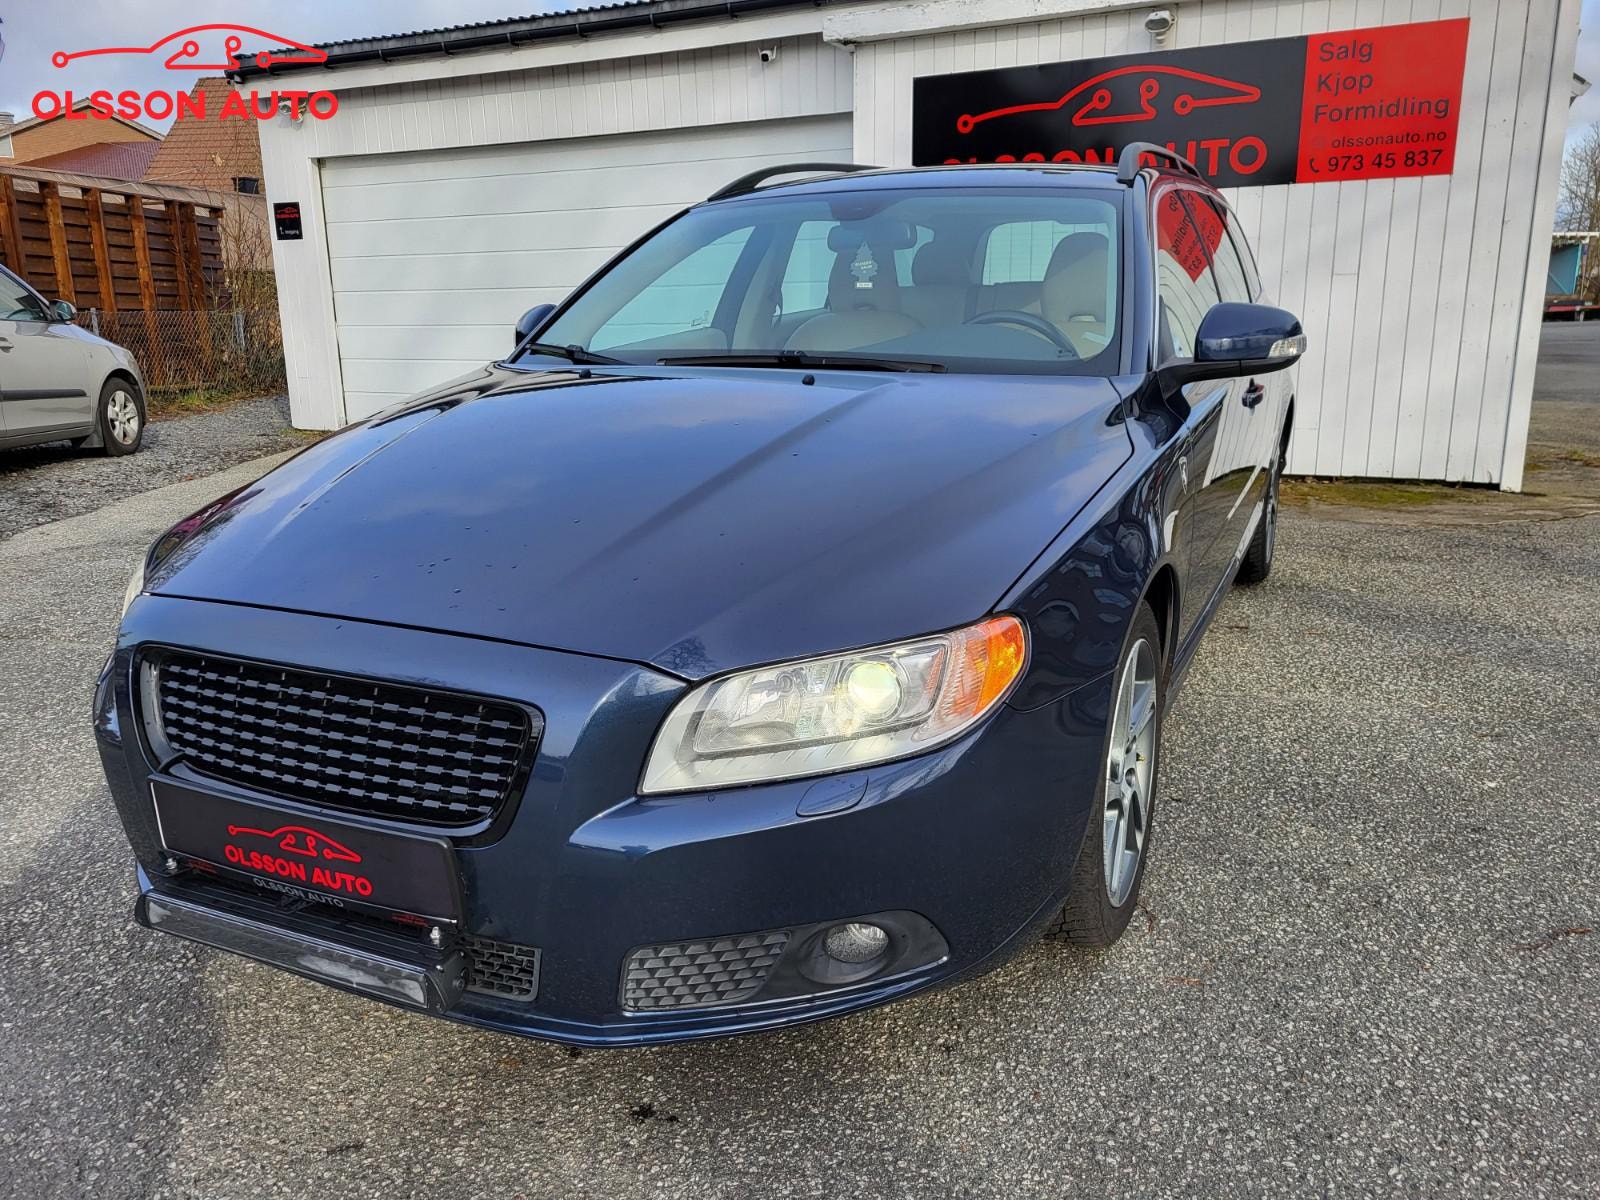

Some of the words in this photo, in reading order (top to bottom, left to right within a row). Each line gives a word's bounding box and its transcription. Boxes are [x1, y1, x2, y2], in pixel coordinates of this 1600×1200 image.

[1319, 39, 1373, 63] Salg
[1314, 97, 1450, 124] Formidling
[1332, 130, 1447, 149] olssonauto.no
[1328, 153, 1364, 173] 973
[1371, 152, 1397, 169] 45
[1403, 149, 1444, 168] 837
[224, 844, 307, 881] OLSSON
[311, 866, 373, 897] AUTO
[253, 877, 305, 898] OLSSON
[308, 892, 344, 908] AUTO
